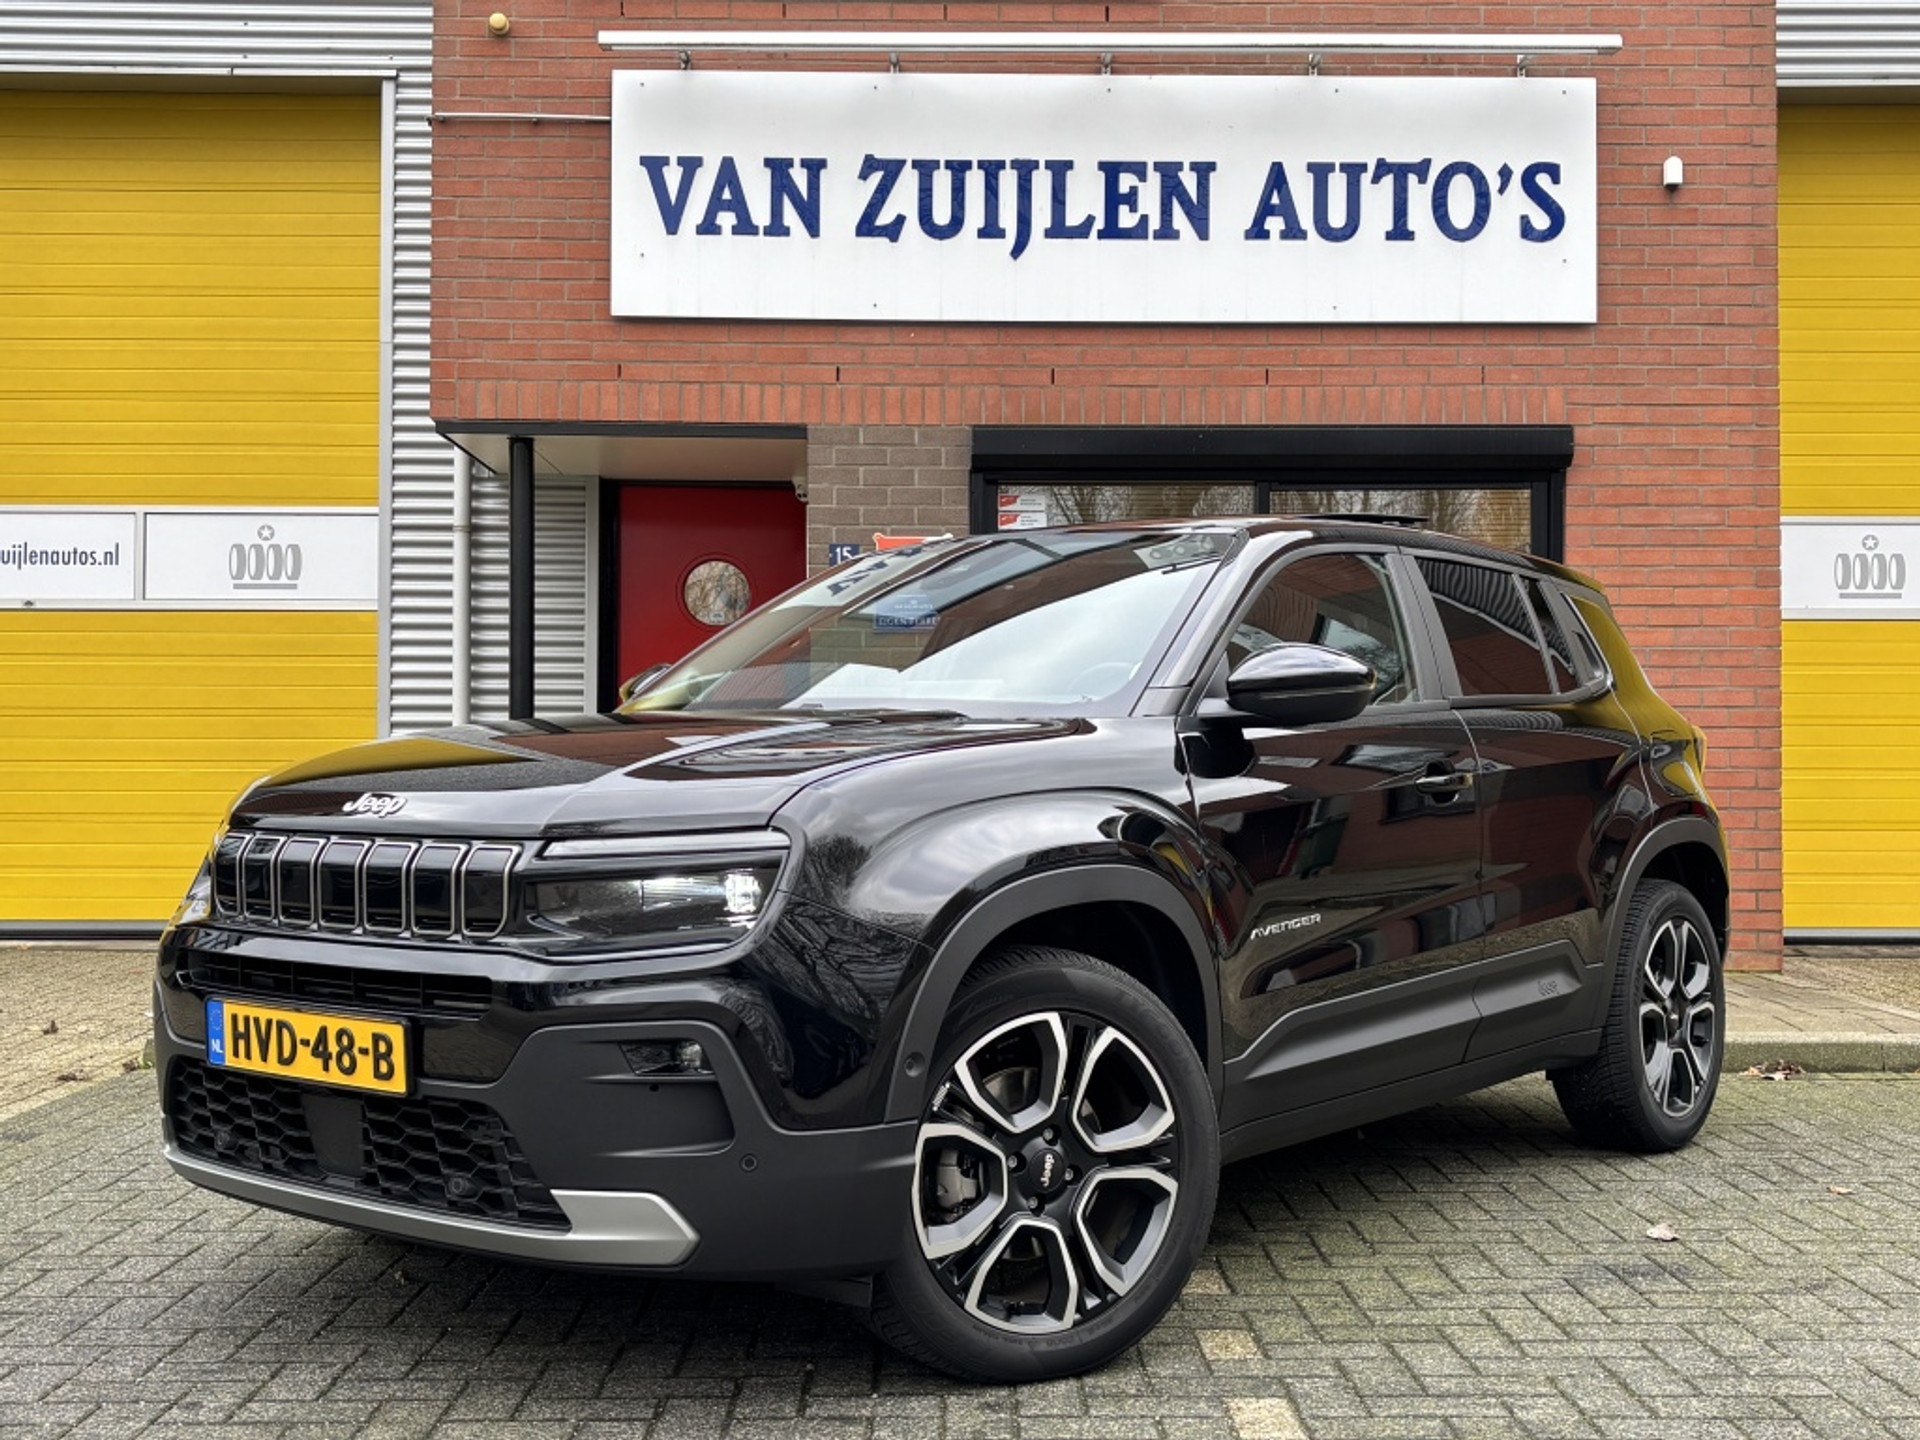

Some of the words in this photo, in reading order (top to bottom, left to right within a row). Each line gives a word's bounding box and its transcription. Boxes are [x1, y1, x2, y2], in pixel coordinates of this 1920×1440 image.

[640, 155, 827, 238] VAN
[854, 153, 1217, 260] ZUIJLEN
[1245, 156, 1567, 243] AUTO'S
[0, 541, 120, 571] uijlenautos.nl
[835, 546, 853, 565] 15
[342, 792, 408, 819] Jeep
[1250, 912, 1322, 941] AVENGER
[211, 1038, 223, 1054] NL
[230, 1012, 395, 1081] HVD-48-B
